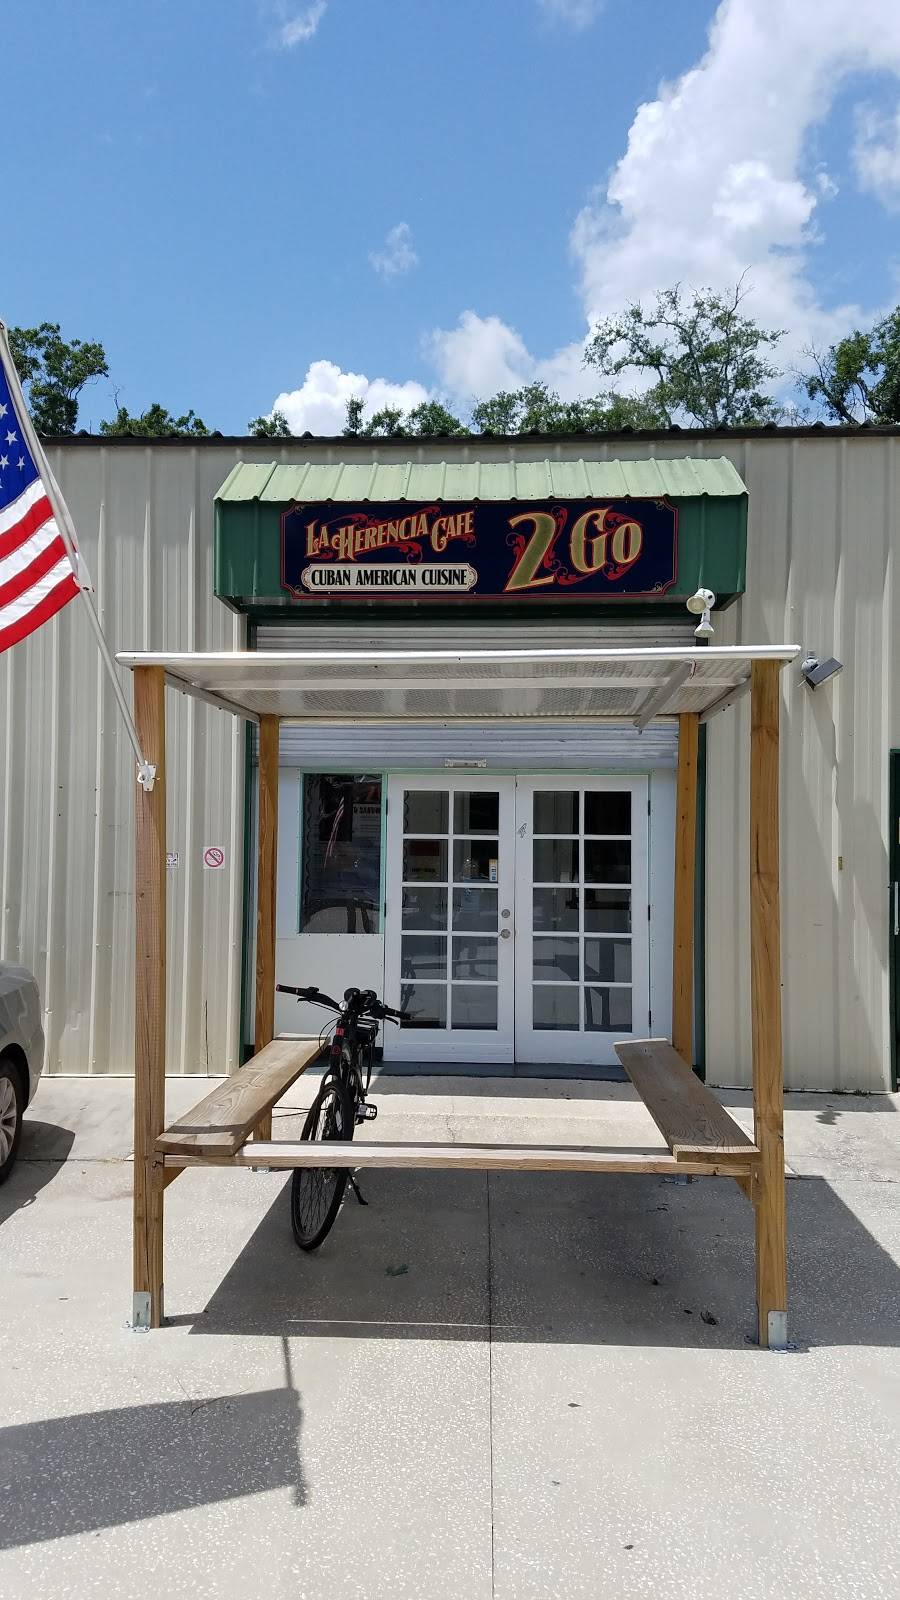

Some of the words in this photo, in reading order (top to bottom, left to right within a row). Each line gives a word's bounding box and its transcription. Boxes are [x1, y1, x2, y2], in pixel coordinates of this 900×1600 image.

[304, 519, 330, 557] LA
[331, 513, 430, 561] HERENCIA
[431, 510, 474, 552] CAFE
[311, 569, 351, 586] CUBAN
[355, 569, 416, 586] AMERICAN
[421, 569, 468, 586] CUISINE
